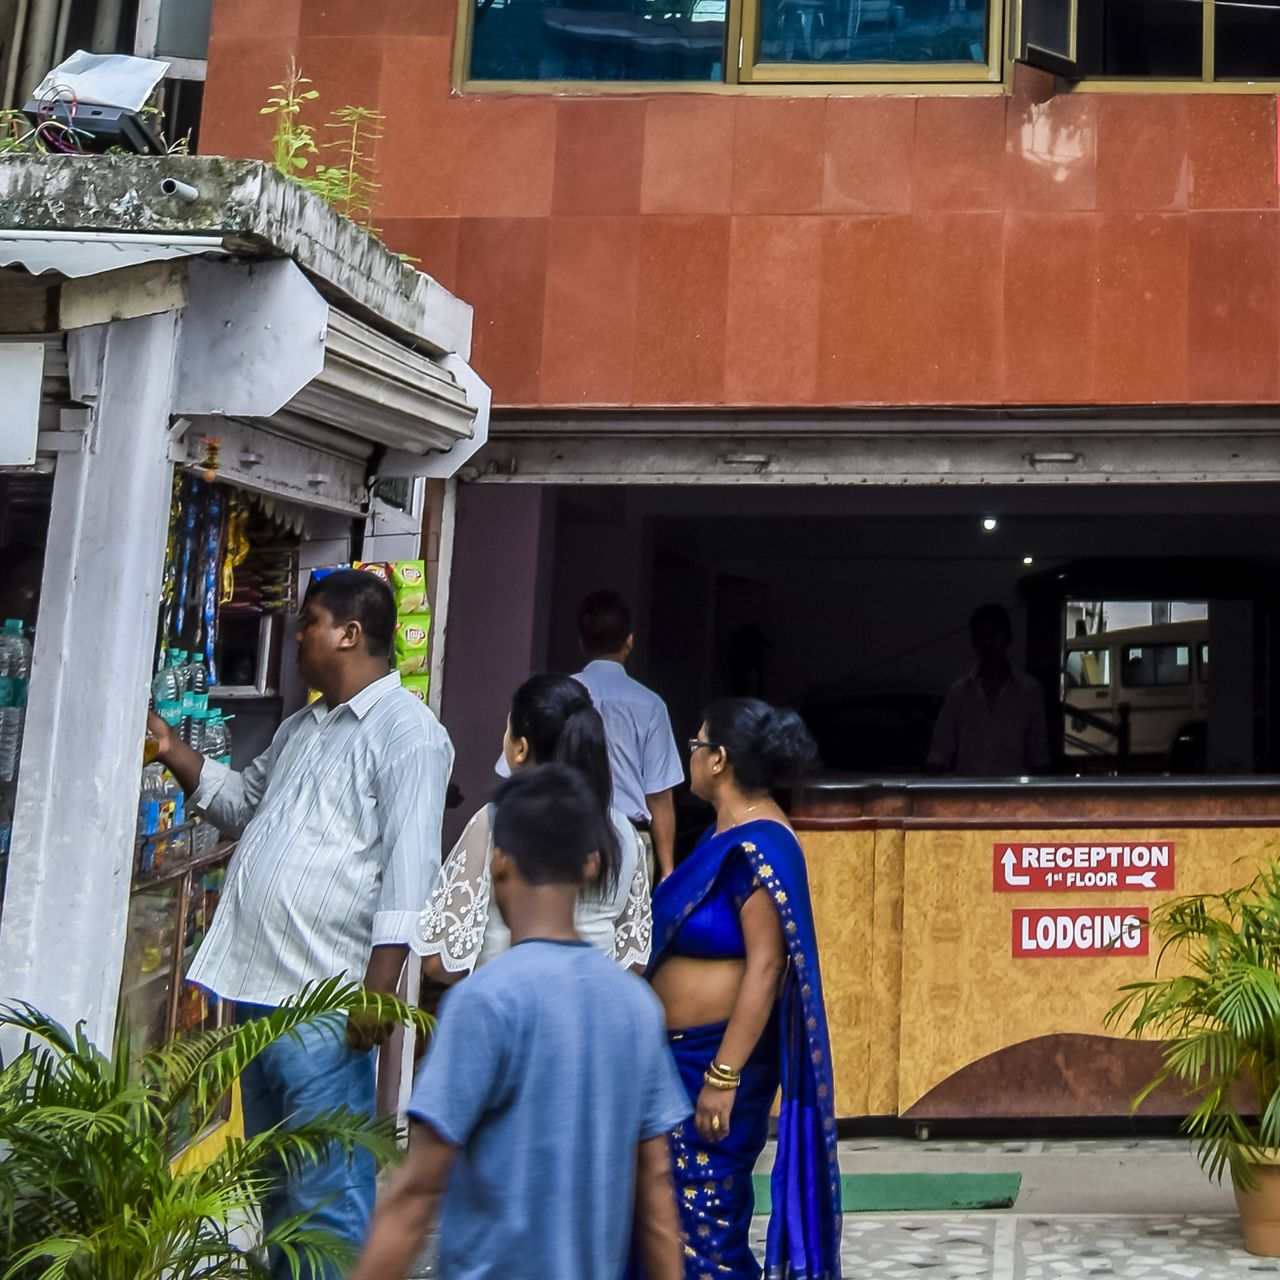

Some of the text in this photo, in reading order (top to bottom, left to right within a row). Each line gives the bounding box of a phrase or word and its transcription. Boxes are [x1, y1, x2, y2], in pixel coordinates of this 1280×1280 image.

[1021, 846, 1169, 868] RECEPTION
[1045, 872, 1118, 887] 1st FLOOR
[1021, 914, 1141, 950] LODGING
